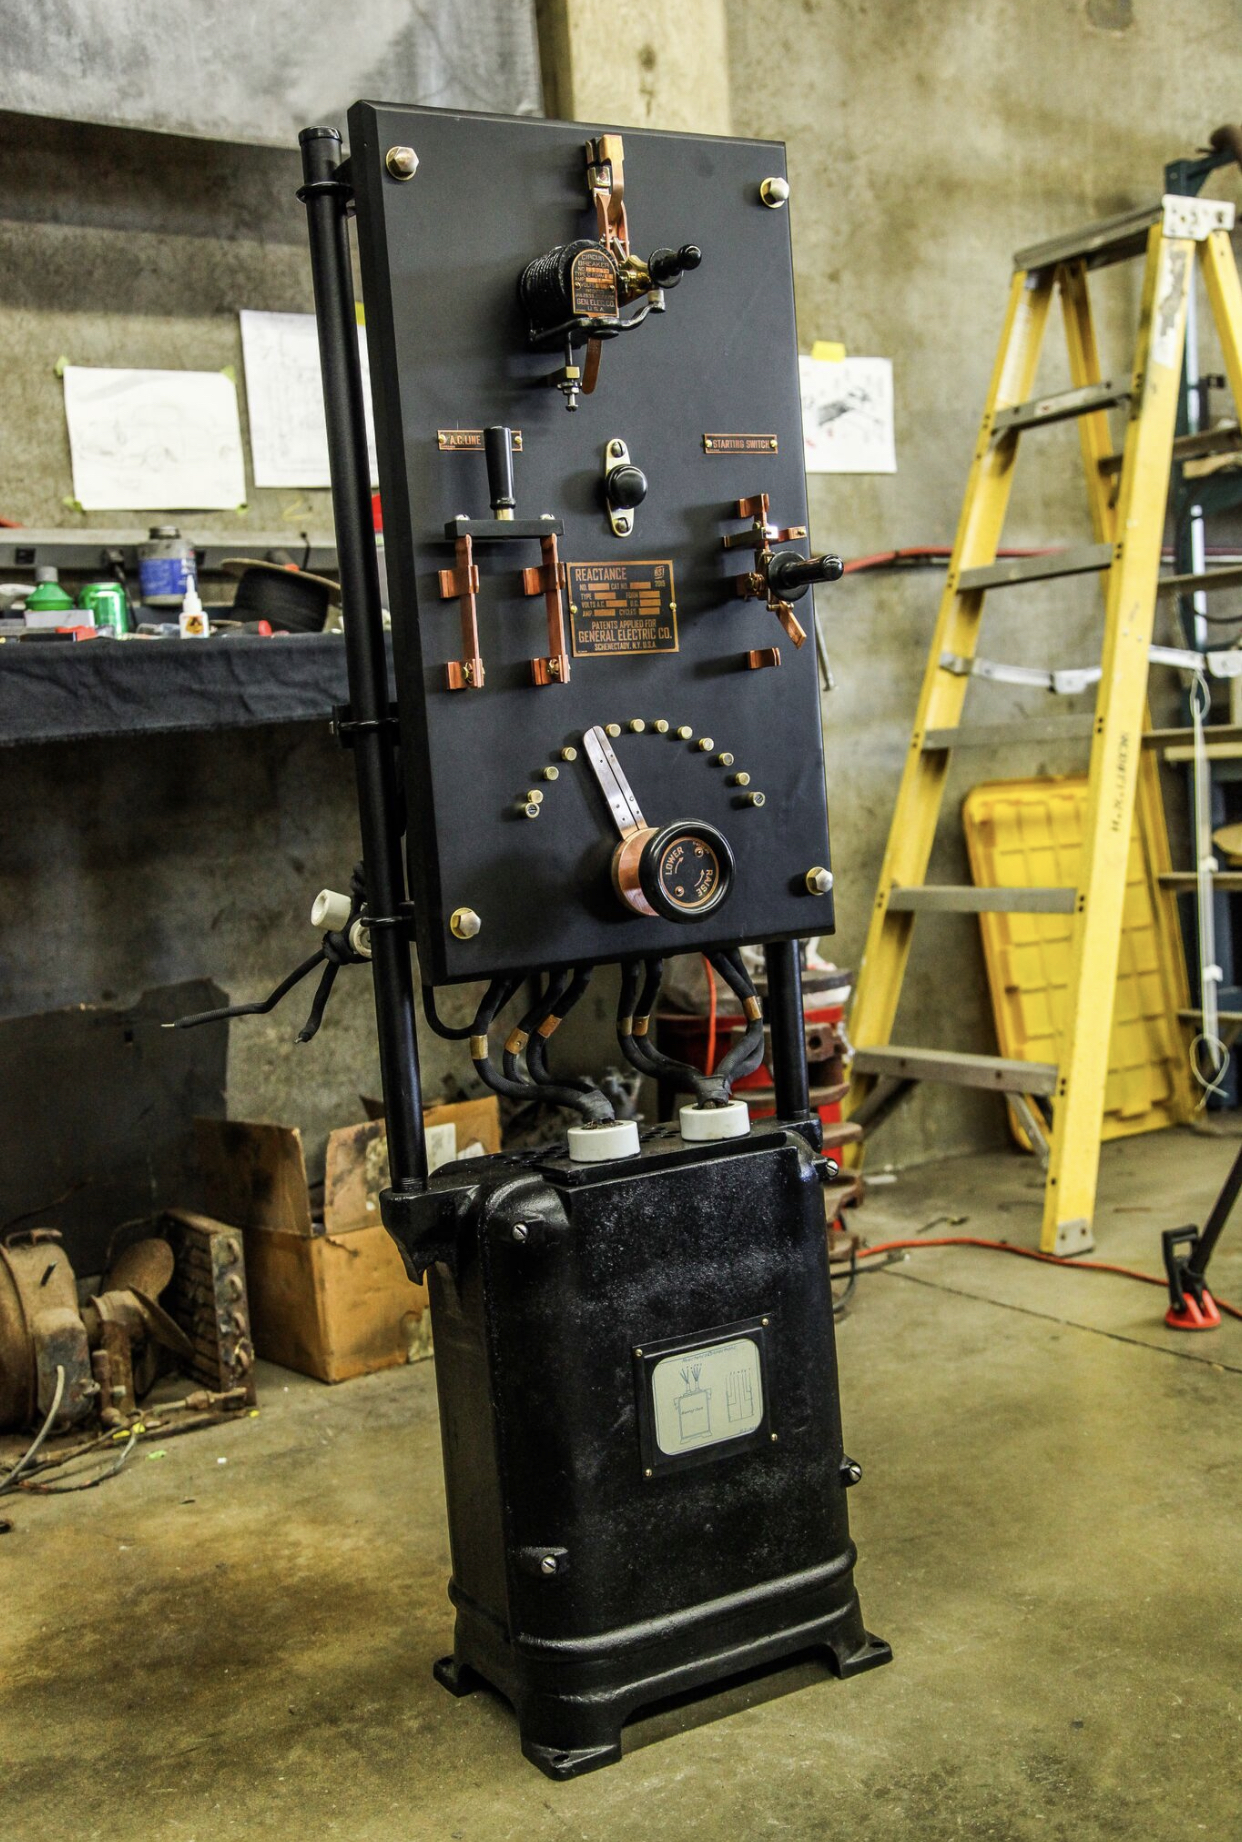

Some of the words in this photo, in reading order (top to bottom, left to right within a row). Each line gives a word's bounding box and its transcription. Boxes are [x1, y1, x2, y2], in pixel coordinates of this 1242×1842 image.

[464, 436, 481, 445] LINE
[712, 440, 744, 448] STARTING
[746, 440, 770, 448] SWITCH
[575, 567, 627, 581] REACTANCE
[592, 620, 618, 630] PATENTS
[620, 620, 643, 628] APPLIED
[645, 619, 656, 627] FOR
[578, 630, 615, 643] GENERAL
[618, 628, 656, 642] ELECTRIC
[658, 627, 672, 639] CO.
[665, 846, 684, 875] LOWER
[696, 869, 713, 897] RAISE
